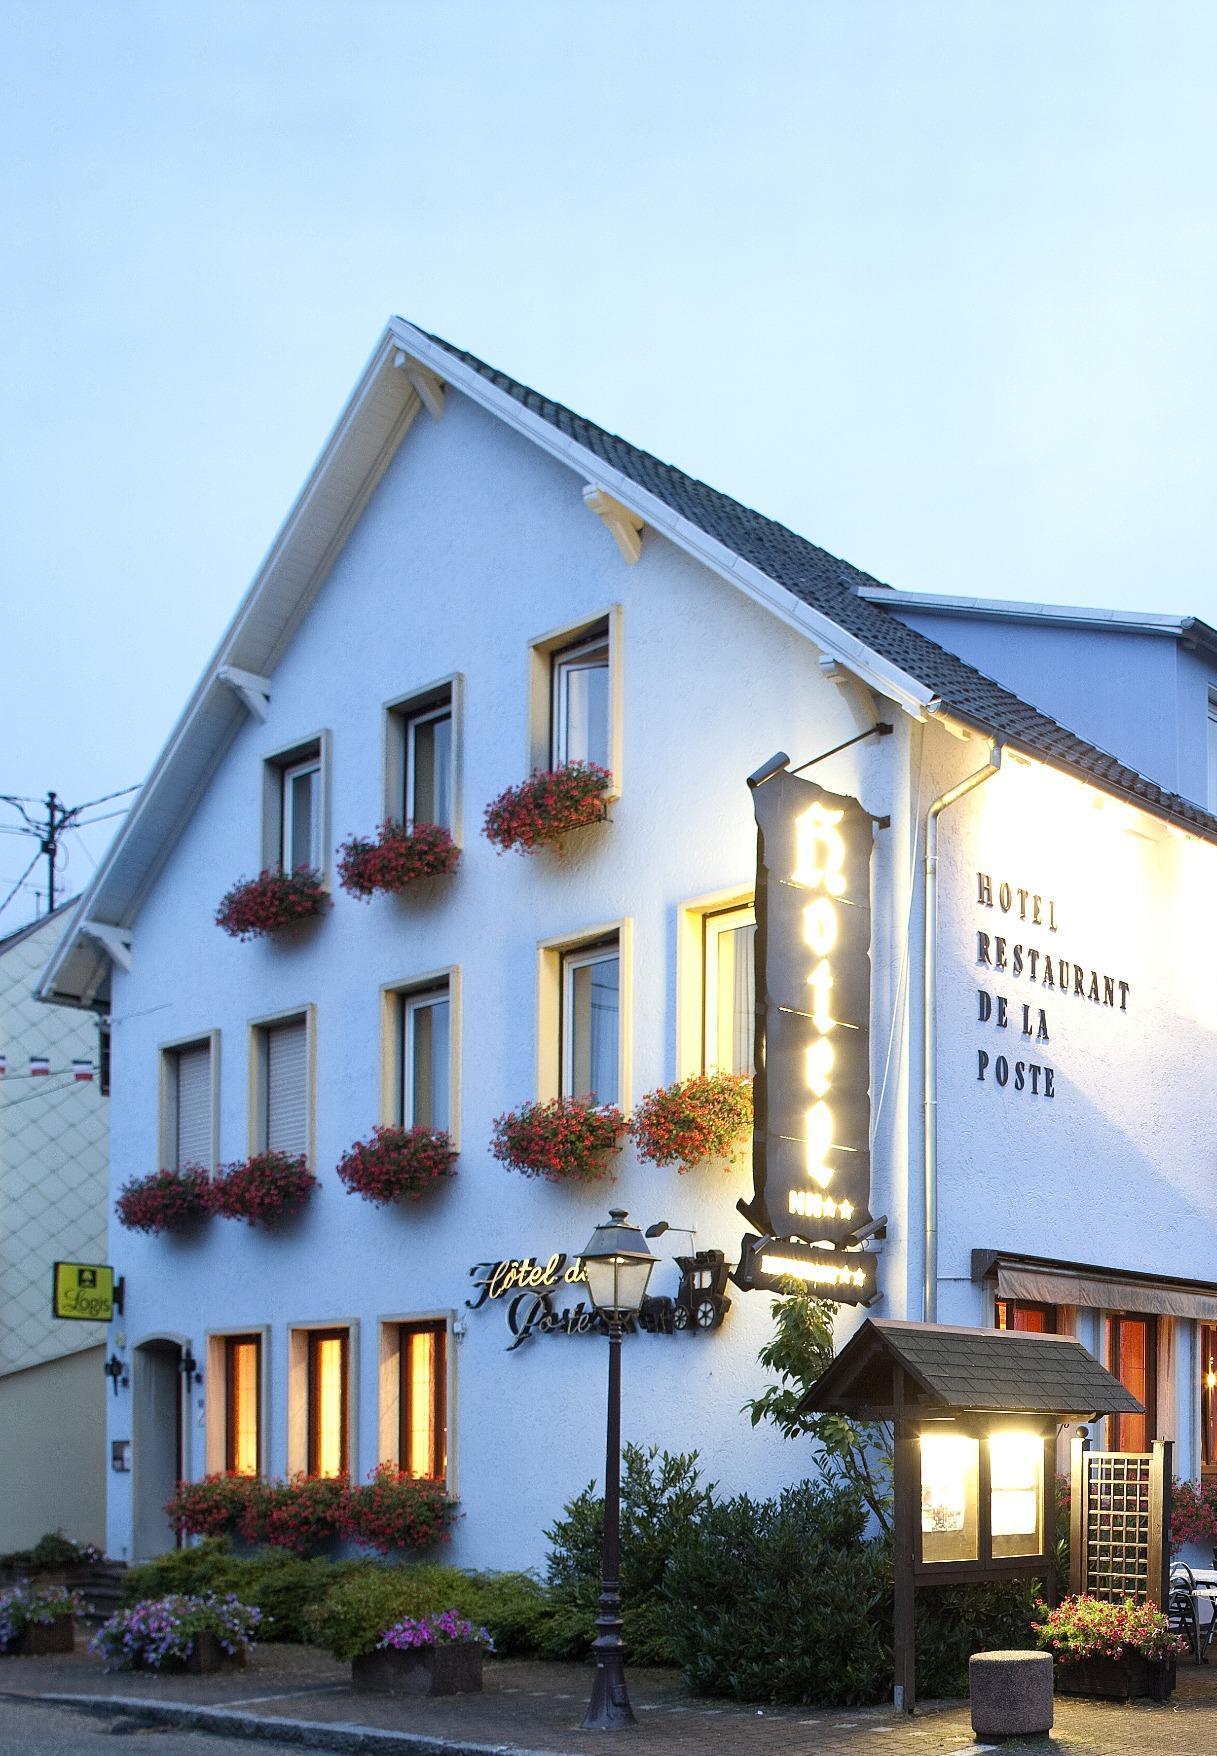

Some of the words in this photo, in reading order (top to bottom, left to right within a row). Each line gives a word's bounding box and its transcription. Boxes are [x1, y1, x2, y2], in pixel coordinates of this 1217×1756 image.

[976, 872, 1058, 933] HOTEL
[976, 930, 1131, 1011] RESTAURANT
[977, 989, 1008, 1029] DE
[1021, 1003, 1050, 1040] LA
[977, 1049, 1055, 1098] POSTE
[63, 1288, 112, 1317] Logis
[465, 1253, 567, 1310] Hôtel
